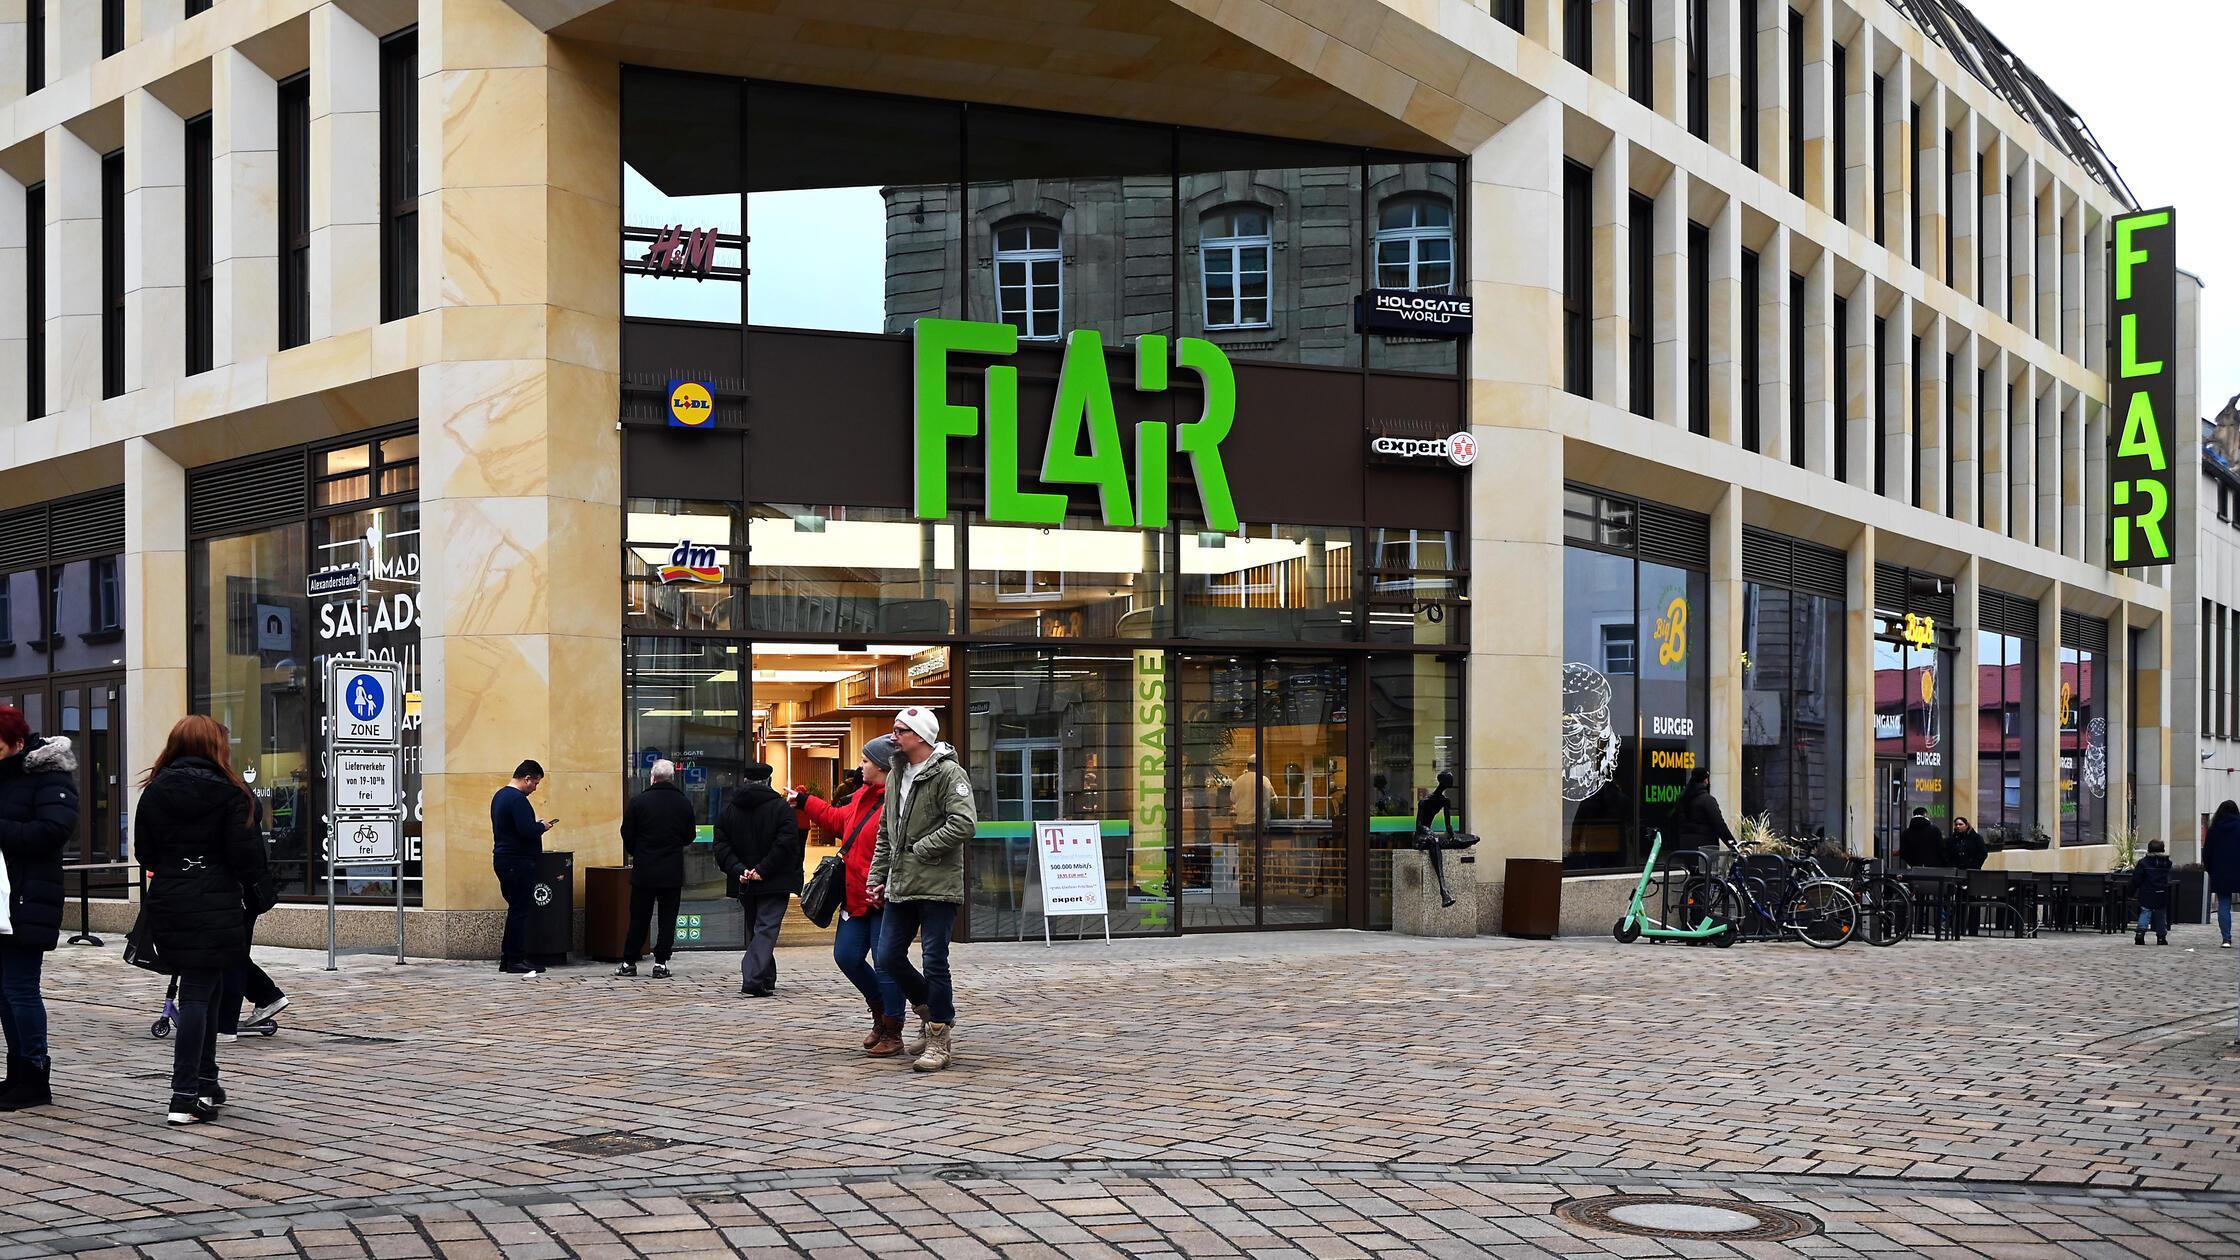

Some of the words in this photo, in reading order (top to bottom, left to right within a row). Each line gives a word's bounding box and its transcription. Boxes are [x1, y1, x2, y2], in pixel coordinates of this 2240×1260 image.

[648, 224, 718, 274] H&M
[1377, 295, 1471, 313] HOLOGATE
[1400, 310, 1451, 323] WORLD
[2113, 212, 2169, 562] FLAIR
[913, 317, 1239, 532] FLAIR
[1377, 439, 1447, 454] expert
[672, 540, 716, 567] dm
[310, 573, 357, 591] Alexanderstraße
[350, 724, 380, 736] ZONE
[1653, 716, 1694, 736] BURGER
[344, 761, 386, 771] Lieferverkehr
[1651, 750, 1696, 769] POMMES
[1916, 751, 1941, 766] BURGER
[346, 777, 357, 785] von
[1915, 778, 1942, 792] POMMES
[359, 791, 373, 800] frei
[1139, 655, 1168, 926] HALLSTRASSE
[359, 845, 373, 854] frei
[1052, 896, 1083, 904] expert
